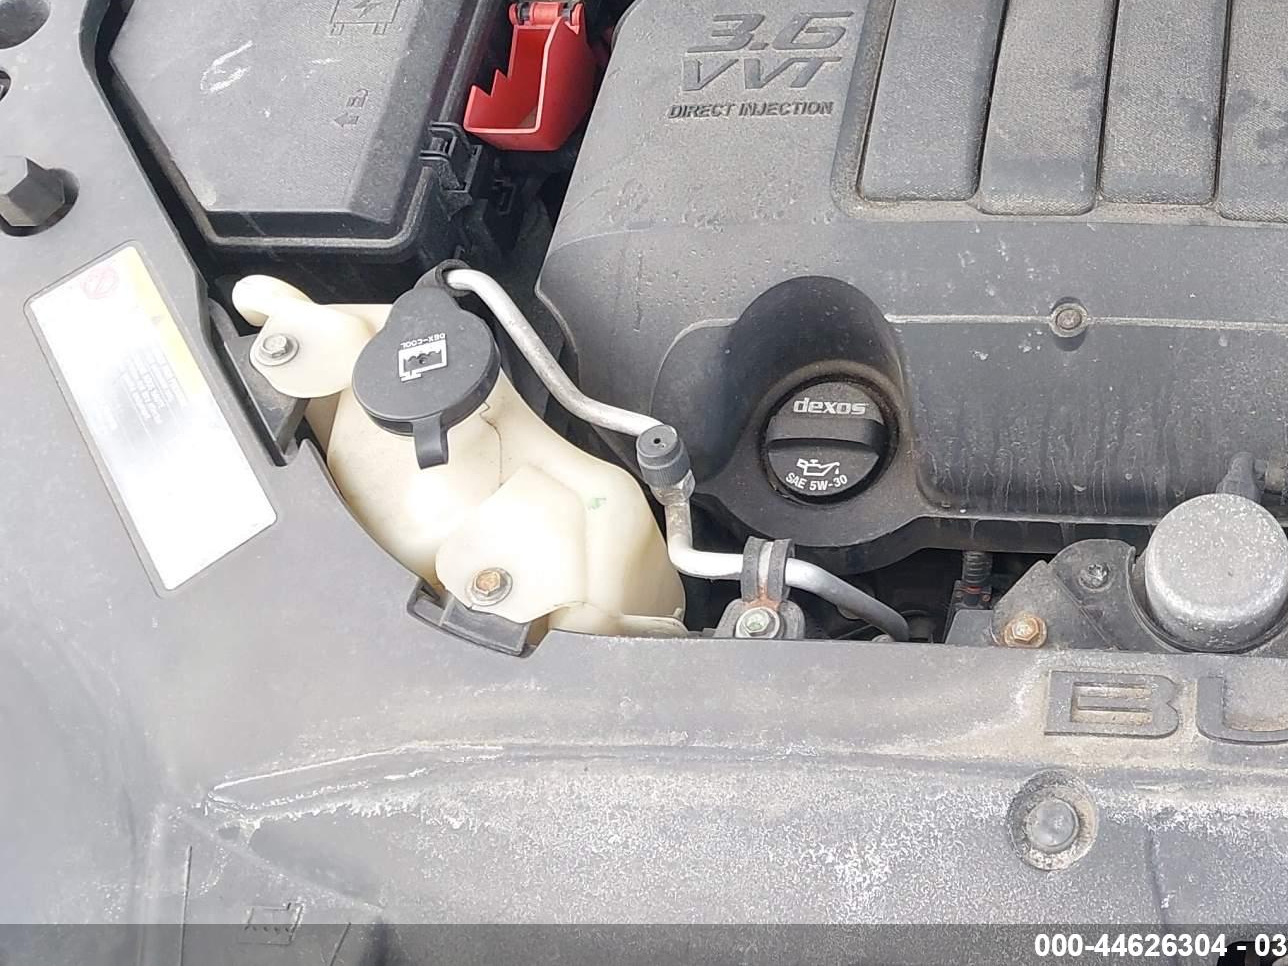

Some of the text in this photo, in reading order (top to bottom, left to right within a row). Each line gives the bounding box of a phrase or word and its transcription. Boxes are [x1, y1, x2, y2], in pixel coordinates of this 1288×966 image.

[686, 11, 855, 54] 3.6
[681, 55, 843, 92] VVT
[668, 101, 834, 119] DIRECT INJECTION
[400, 332, 446, 349] DEX-COOL
[793, 397, 869, 415] dexos
[785, 472, 848, 491] SAE 5W-30
